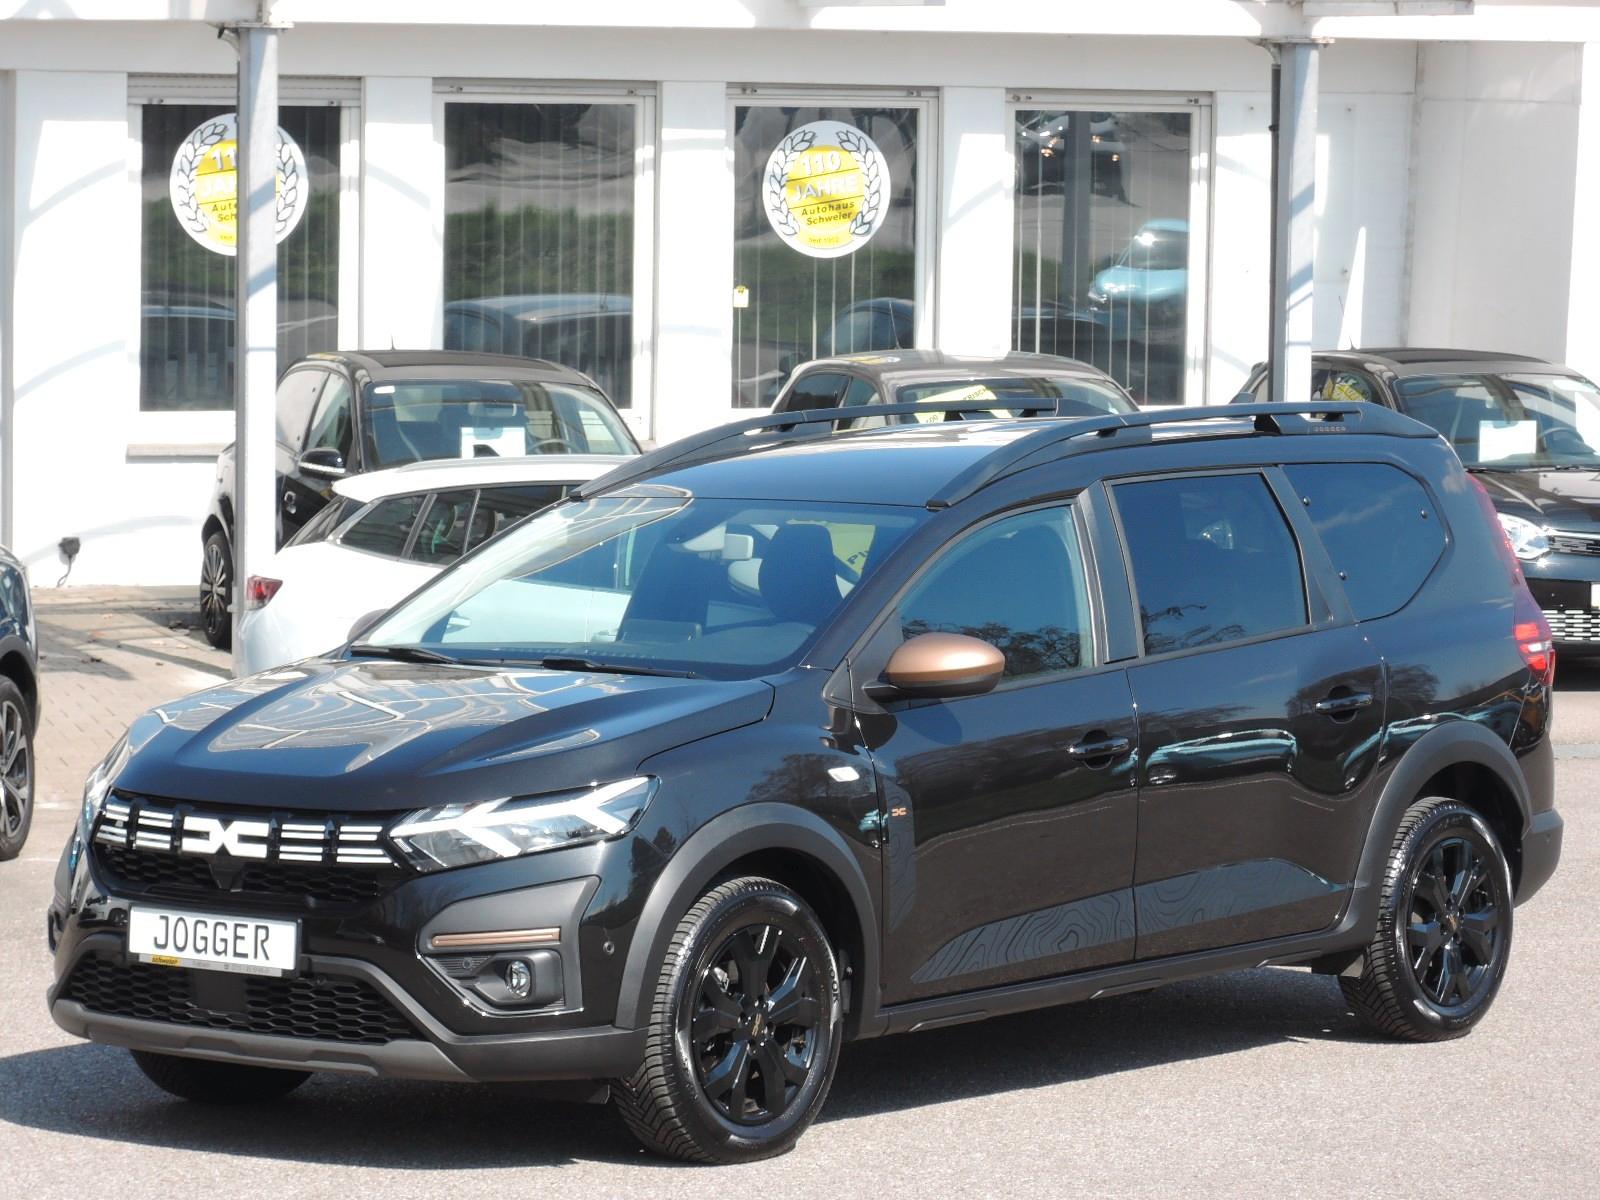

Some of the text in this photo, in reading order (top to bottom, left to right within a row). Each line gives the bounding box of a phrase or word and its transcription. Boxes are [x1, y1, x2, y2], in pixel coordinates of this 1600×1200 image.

[212, 149, 237, 170] 11
[800, 151, 841, 175] 110
[792, 175, 858, 201] JAHRE
[801, 201, 855, 216] Autohaus
[806, 211, 853, 226] Schweier
[153, 914, 270, 961] JOGGER
